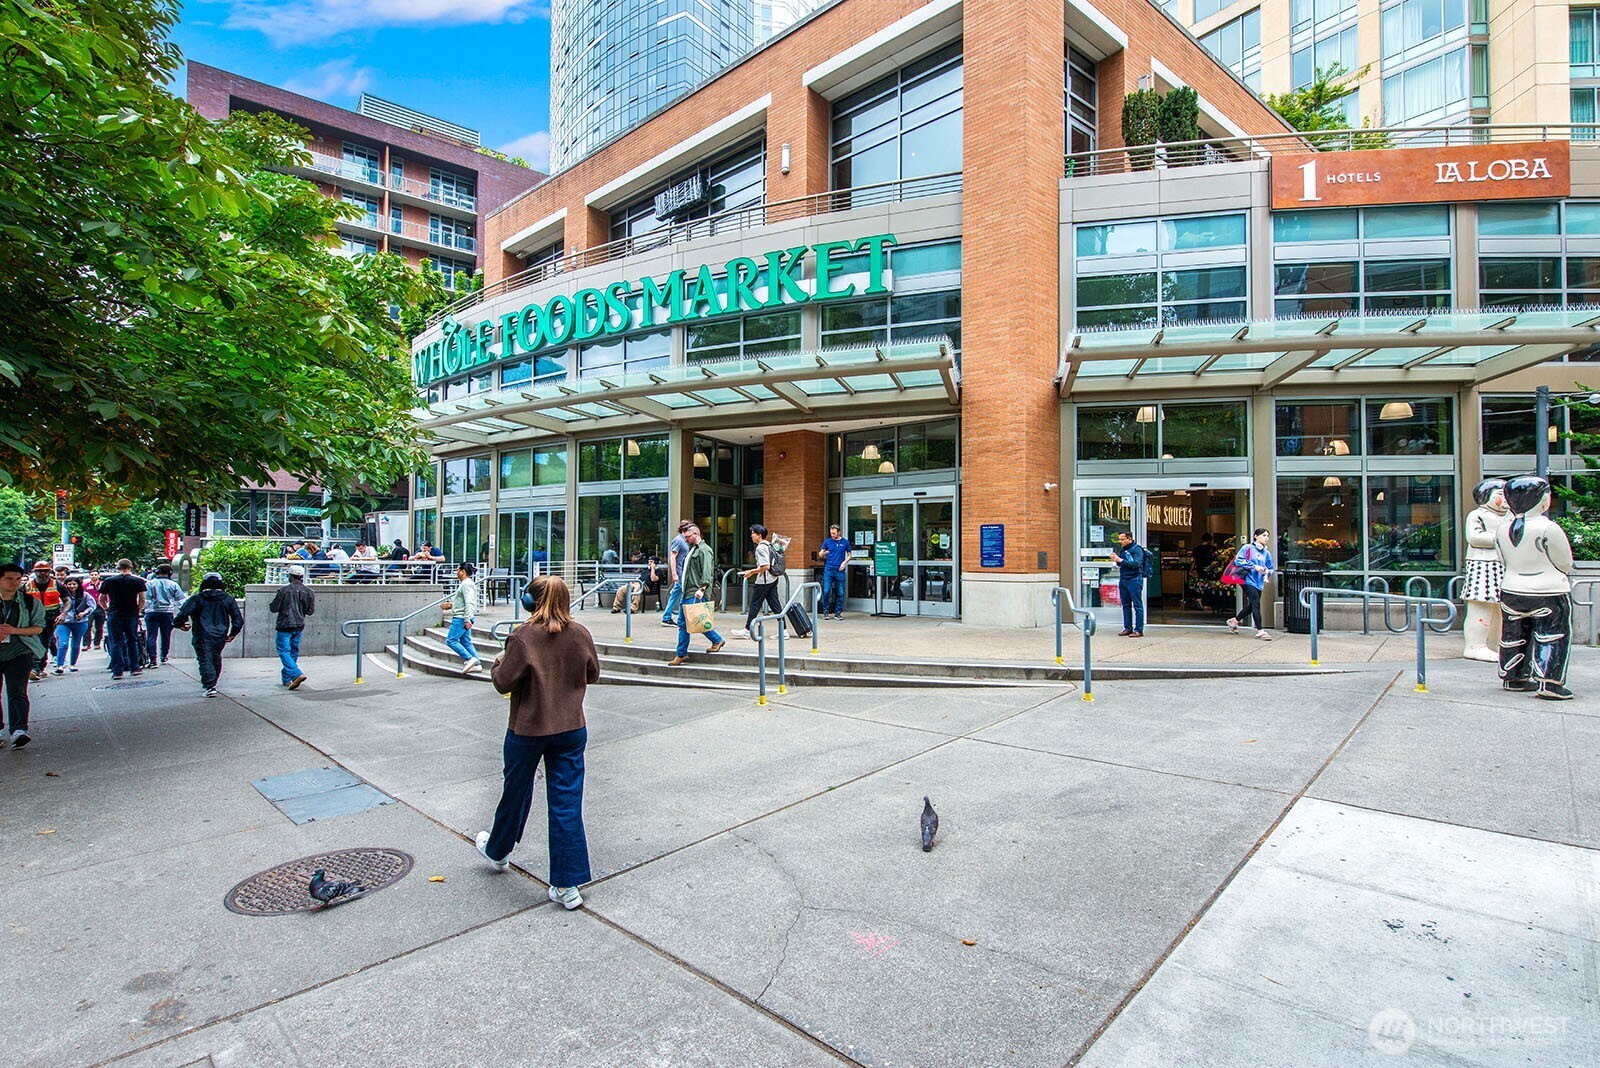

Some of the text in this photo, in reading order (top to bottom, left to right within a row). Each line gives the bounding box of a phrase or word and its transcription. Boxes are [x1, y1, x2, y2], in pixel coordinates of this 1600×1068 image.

[1298, 159, 1381, 201] 1 HOTELS
[1467, 157, 1552, 182] LOBA
[413, 233, 898, 388] WHOLE FOODS MARKET
[291, 507, 309, 515] Denny
[168, 532, 176, 557] BECU
